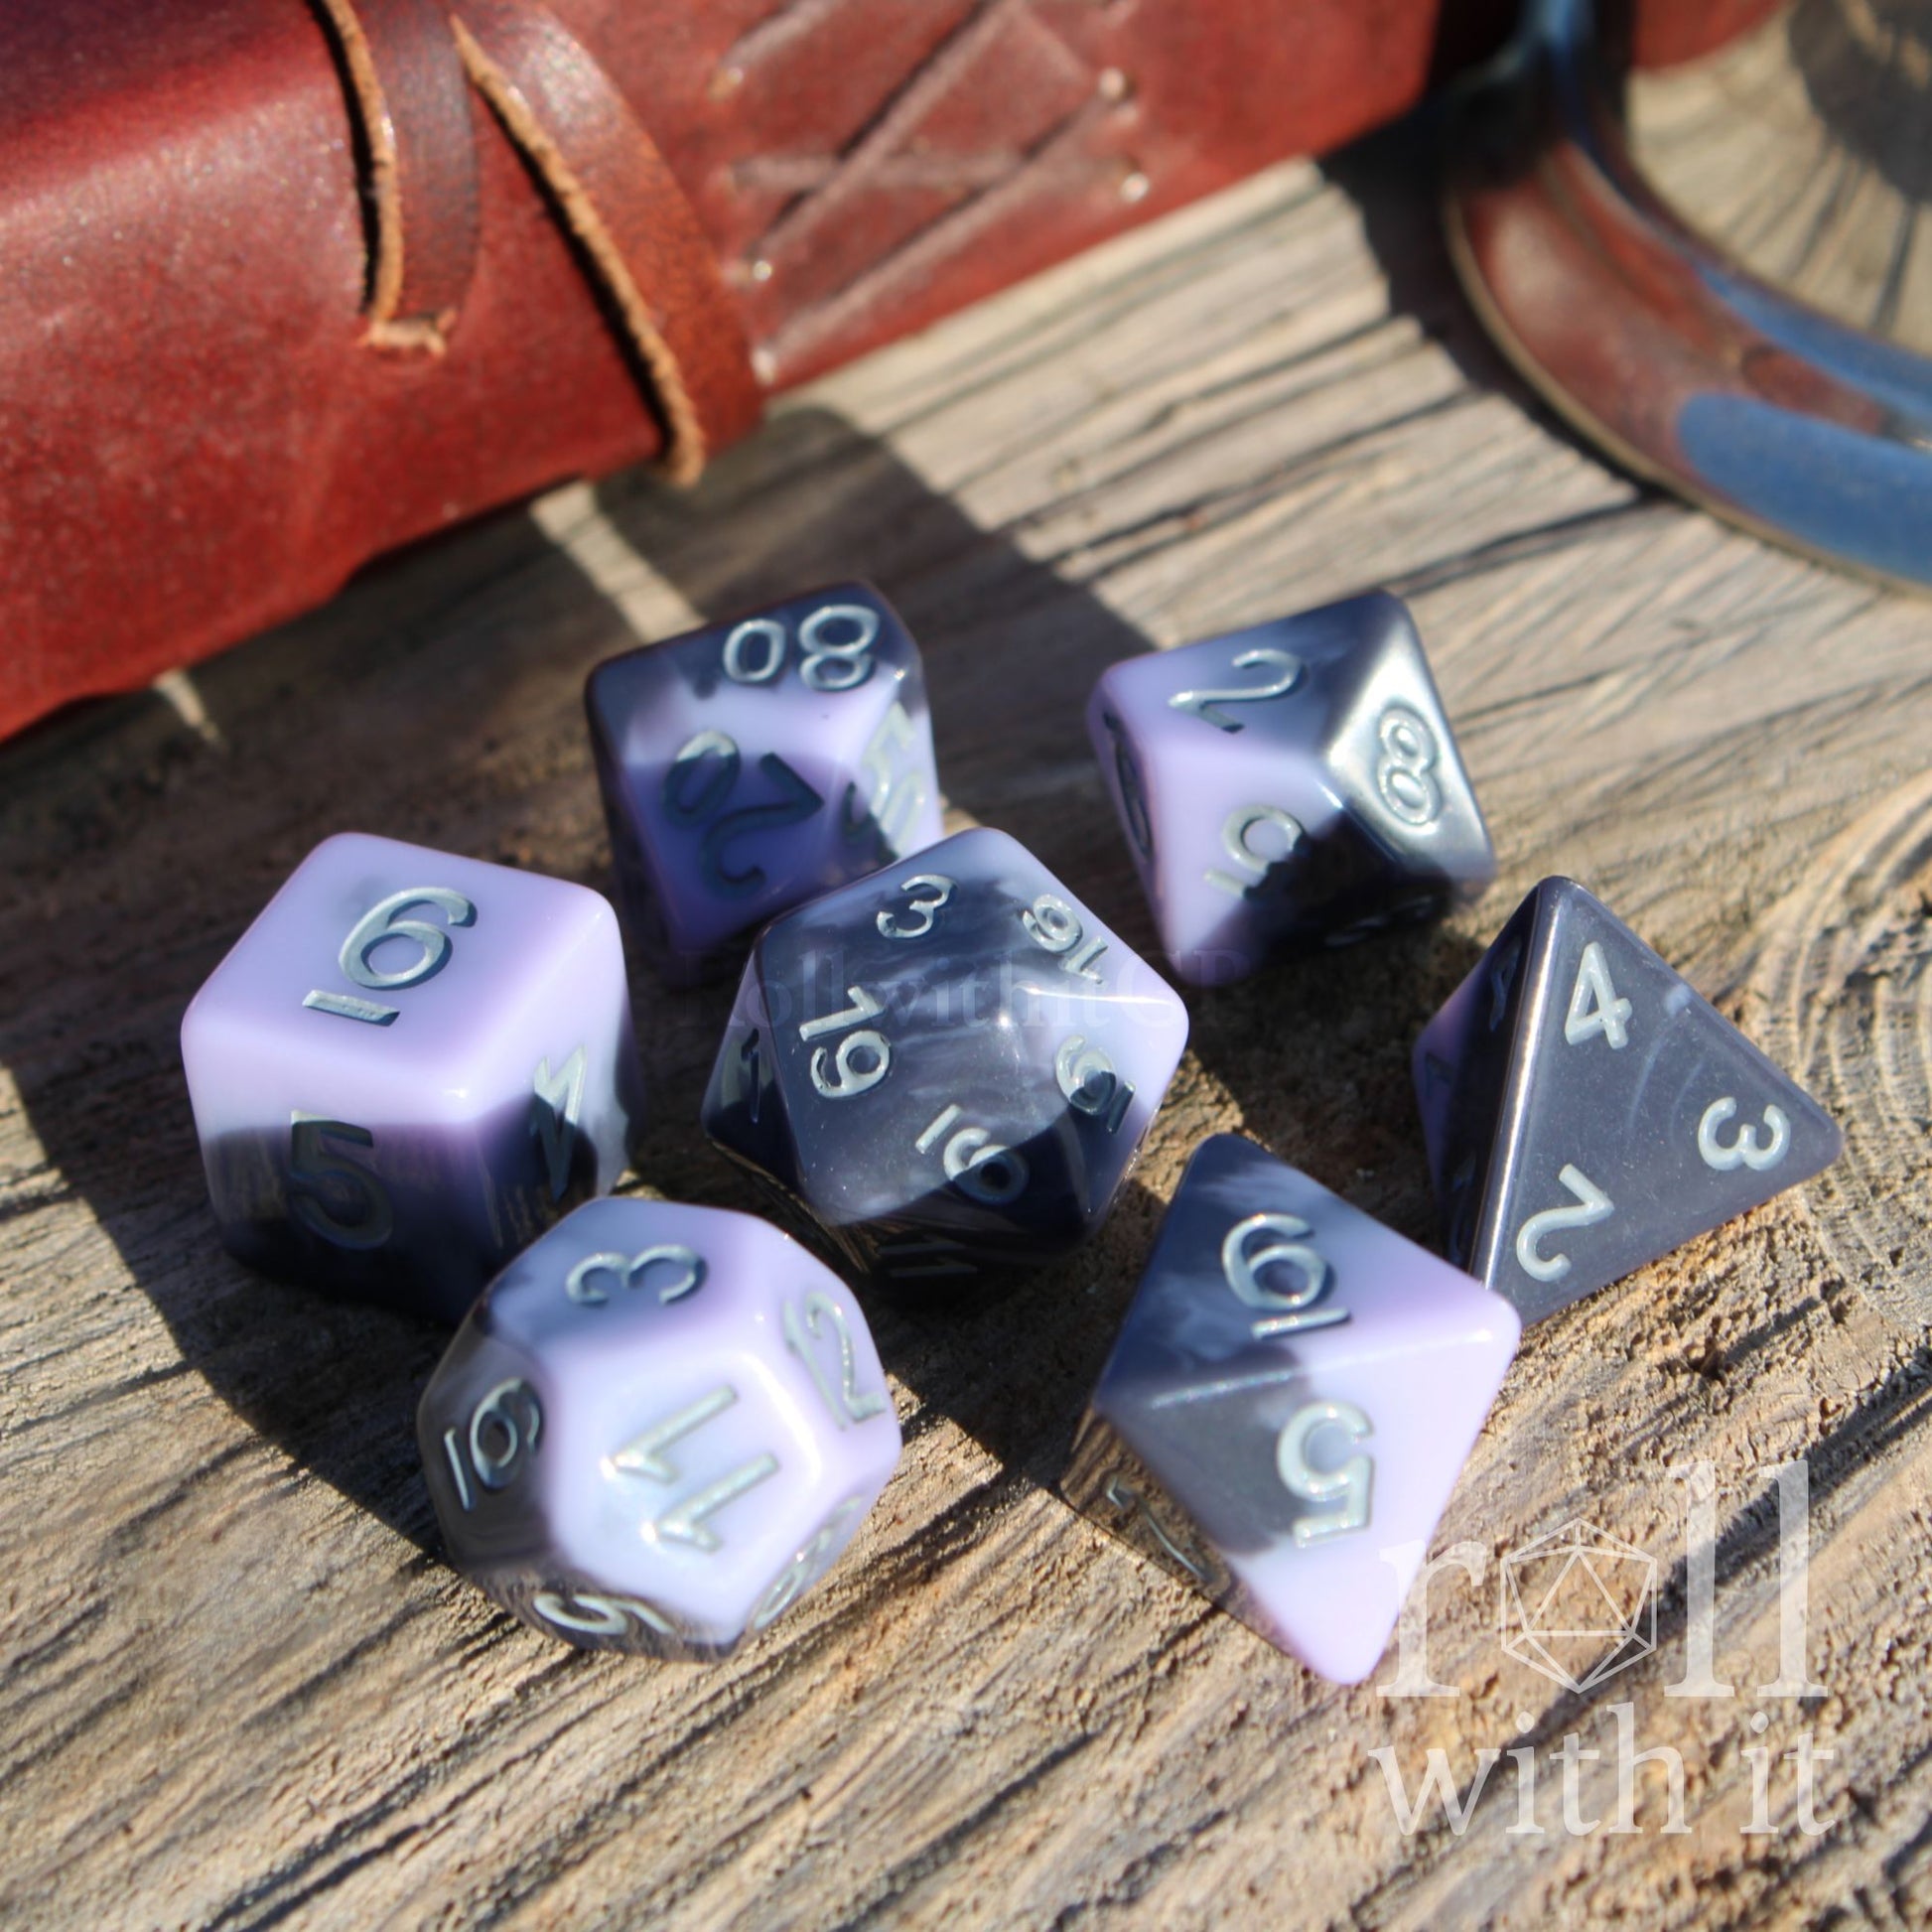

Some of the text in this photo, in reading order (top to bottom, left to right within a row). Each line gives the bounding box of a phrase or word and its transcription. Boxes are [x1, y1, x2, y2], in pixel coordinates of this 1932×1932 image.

[1168, 648, 1309, 735] 2
[1377, 701, 1440, 829] 8
[339, 886, 479, 992] 6
[876, 874, 959, 939] 3
[798, 985, 892, 1100] 19
[1565, 941, 1633, 1049] 4
[290, 1109, 395, 1251] 5
[1697, 1096, 1791, 1172] 3
[564, 1244, 708, 1310] 3
[1220, 1212, 1338, 1311] 6
[1516, 1163, 1615, 1283] 2
[781, 1293, 889, 1432] 12
[599, 1385, 781, 1556] 11
[1277, 1401, 1375, 1550] 5
